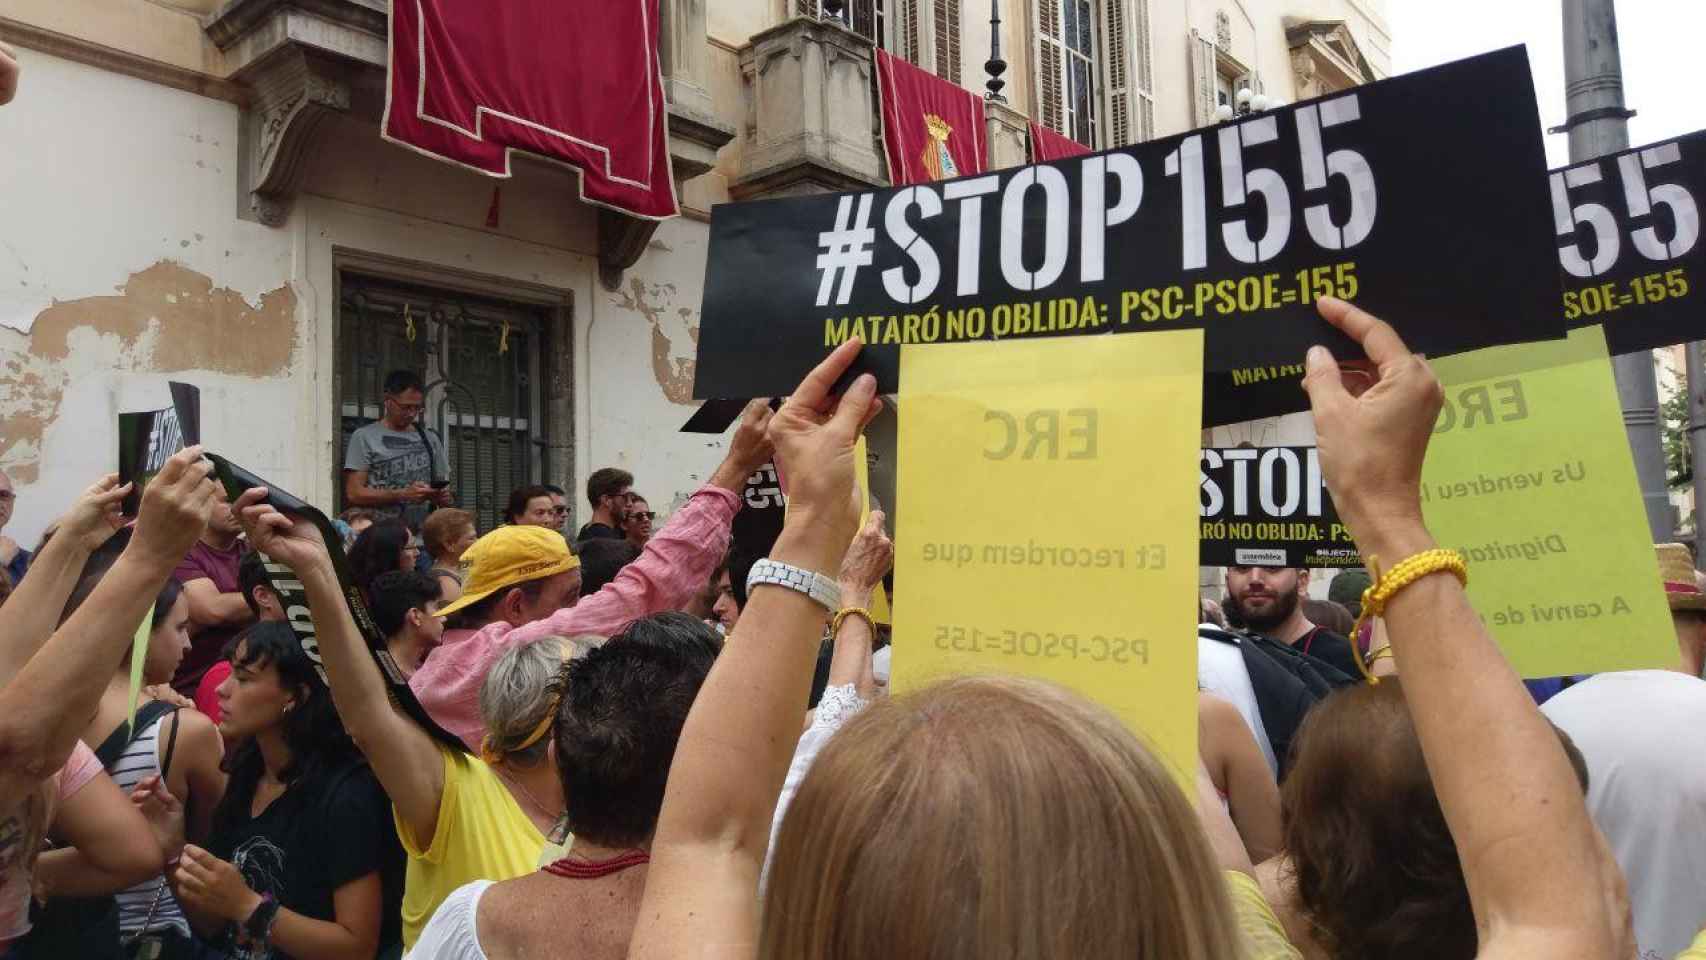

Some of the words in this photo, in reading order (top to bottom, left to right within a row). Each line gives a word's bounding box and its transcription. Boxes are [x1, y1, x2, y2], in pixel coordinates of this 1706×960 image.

[815, 149, 1144, 306] #STOP
[1164, 94, 1378, 271] 155
[824, 305, 941, 347] MATARÓ
[946, 310, 984, 340] NO
[991, 297, 1108, 338] OBLIDA:
[1121, 261, 1359, 325] PSC-PSOE=155
[1230, 522, 1253, 540] NO
[1256, 522, 1324, 541] OBLIDA:
